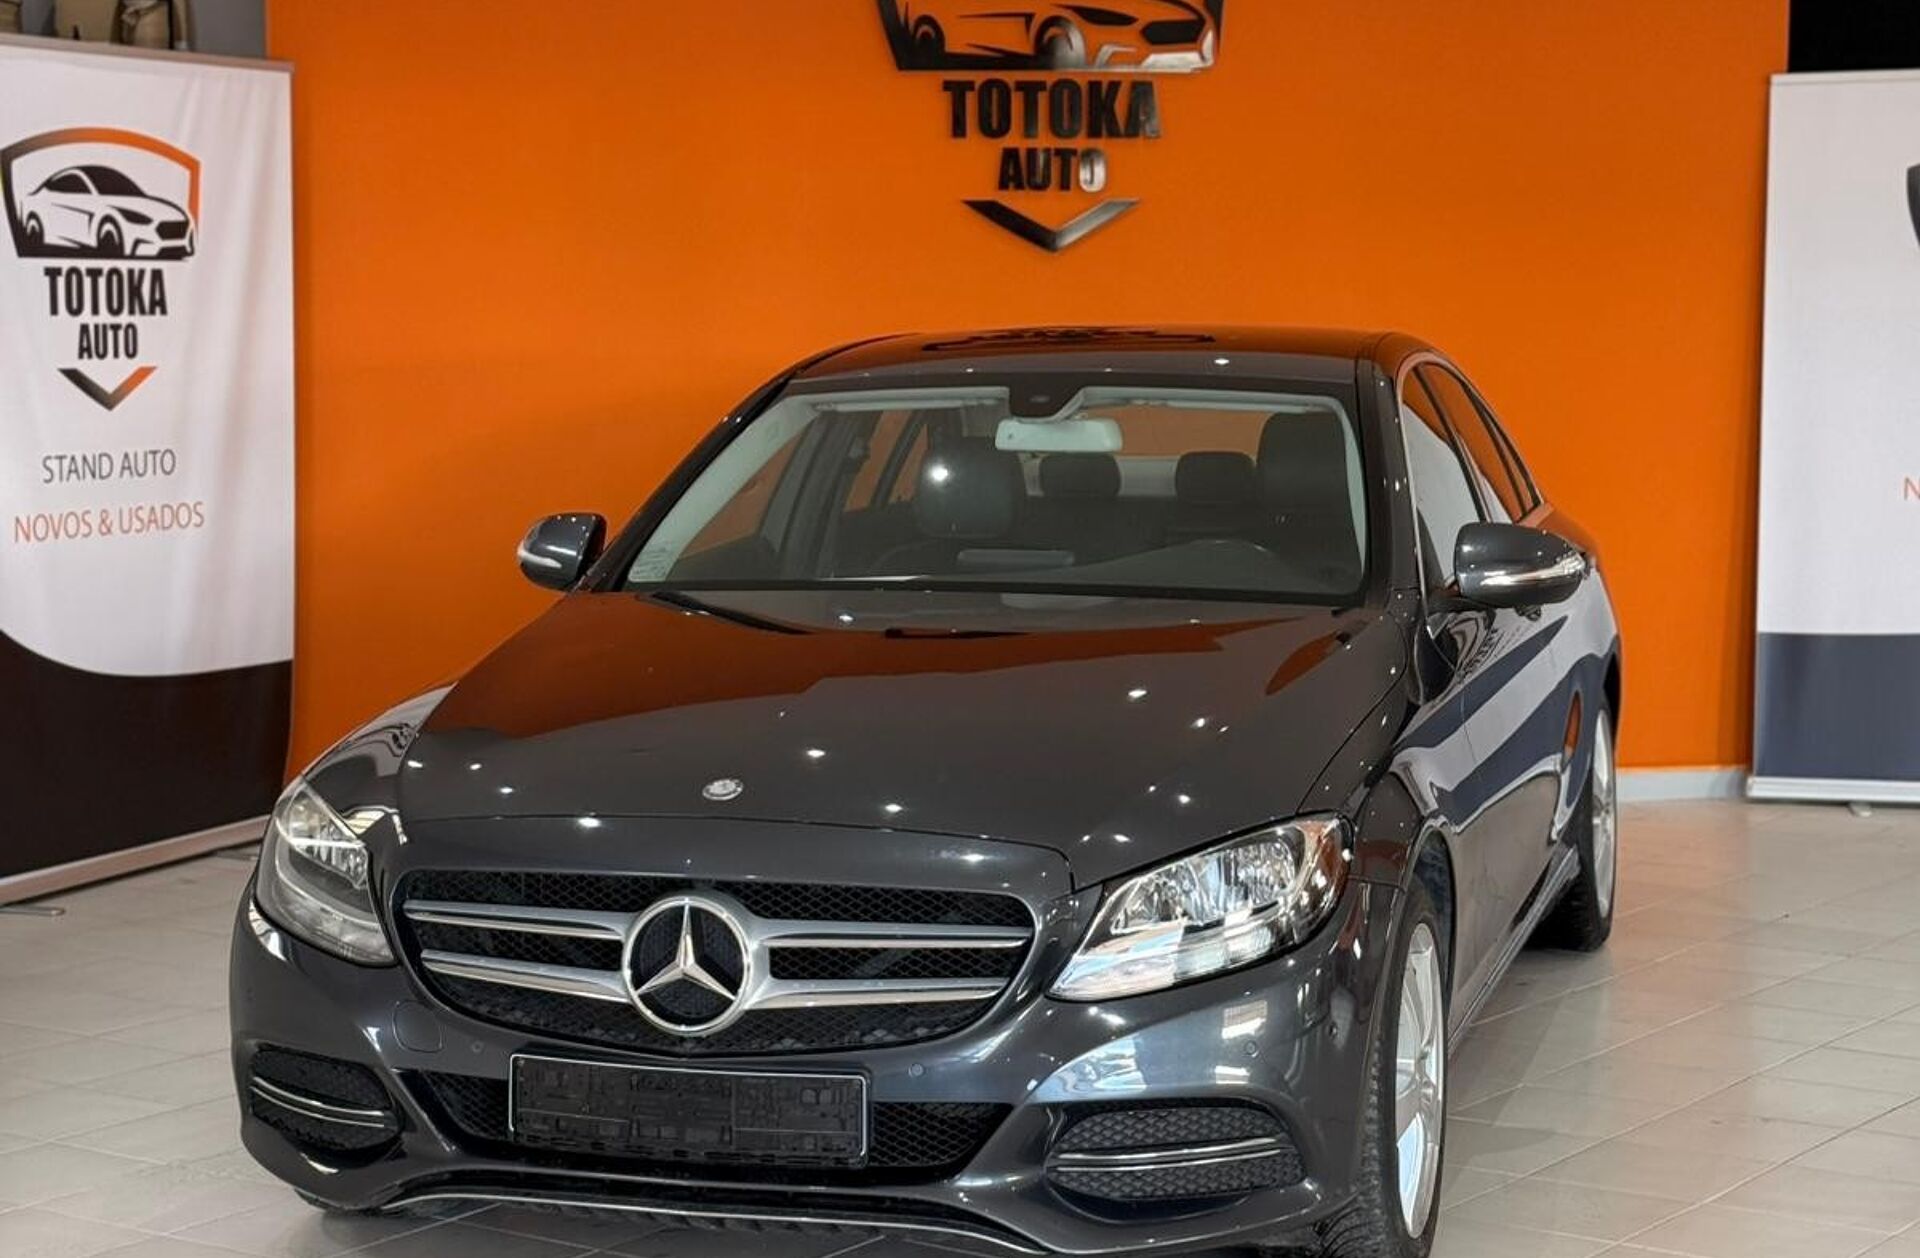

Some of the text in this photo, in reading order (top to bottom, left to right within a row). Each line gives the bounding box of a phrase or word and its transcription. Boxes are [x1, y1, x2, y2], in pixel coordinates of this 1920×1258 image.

[942, 79, 1161, 139] TOTOKA
[998, 147, 1107, 192] AUTO
[44, 267, 168, 316] TOTOKA
[78, 323, 138, 360] AUTO
[42, 449, 176, 484] STAND AUTO
[14, 502, 205, 543] NOVOS & USADOS
